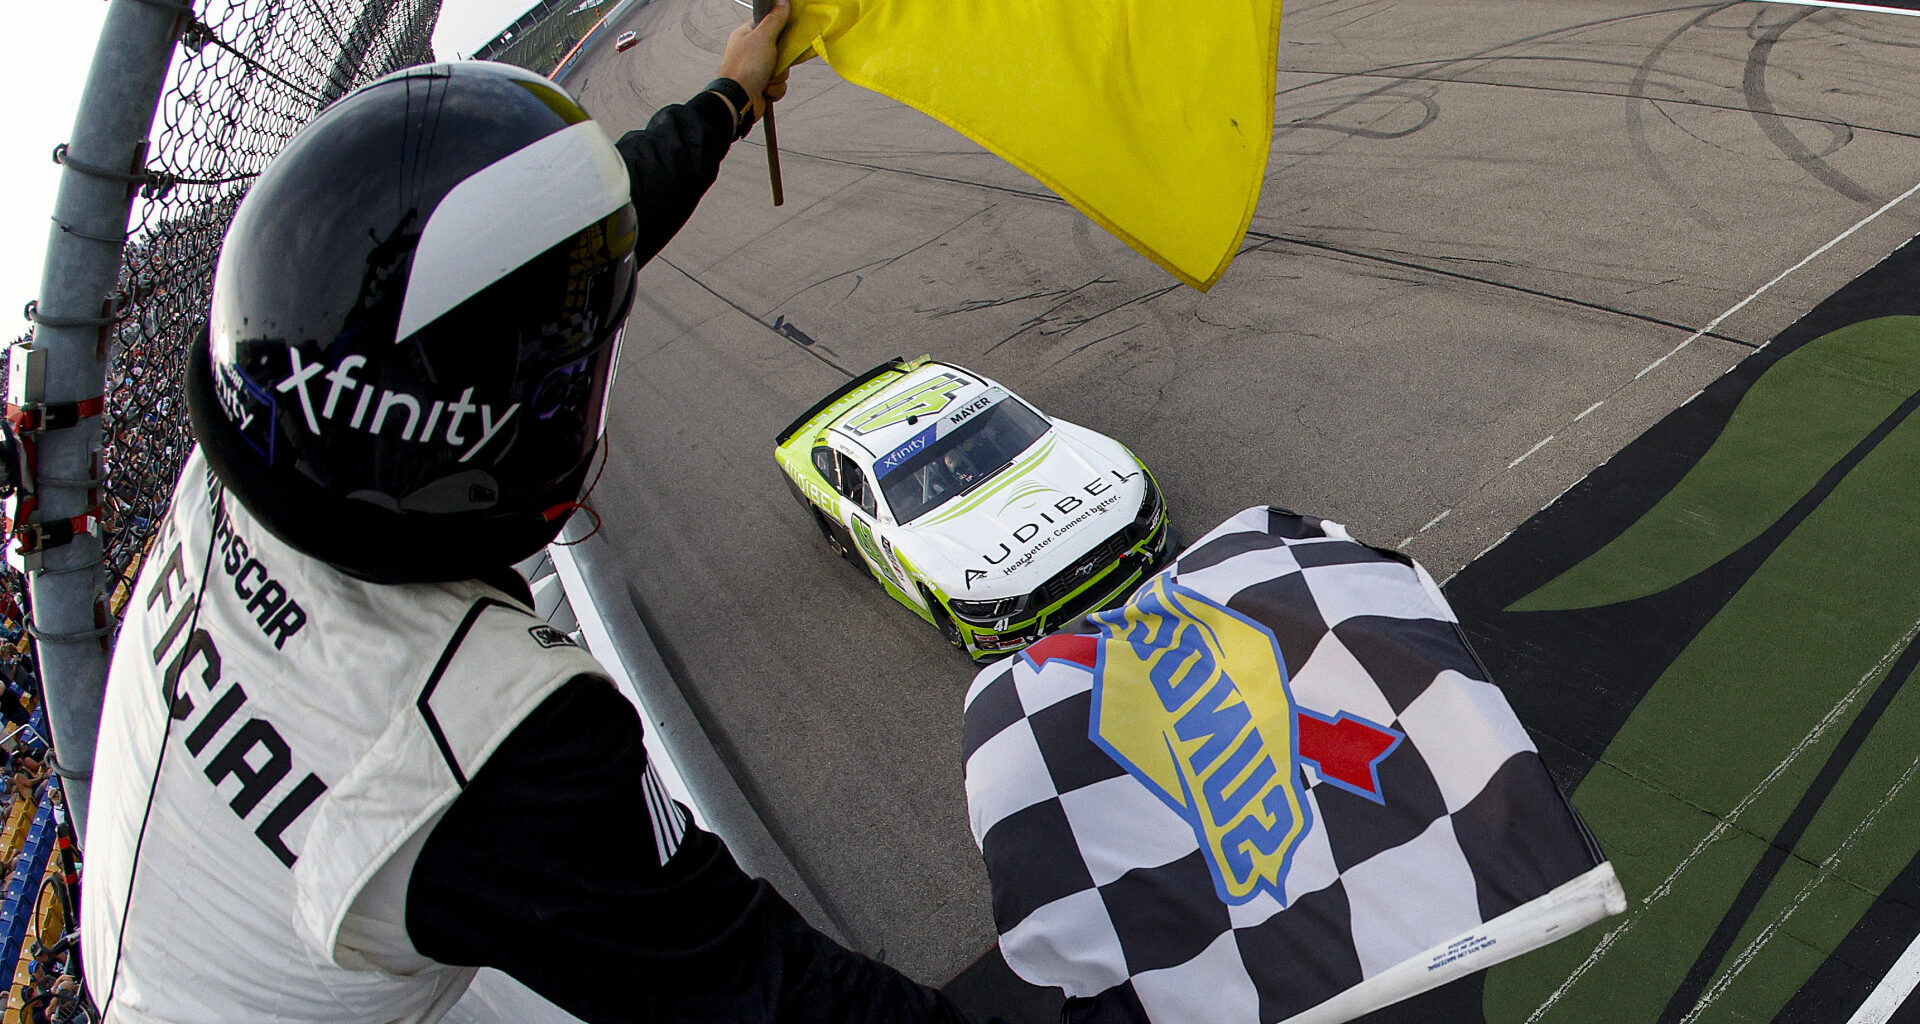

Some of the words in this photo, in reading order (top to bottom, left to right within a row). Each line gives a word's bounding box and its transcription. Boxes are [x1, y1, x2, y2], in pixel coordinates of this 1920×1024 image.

[276, 346, 521, 462] xfinity
[950, 397, 991, 424] MAYER
[884, 436, 926, 468] xfinity
[965, 470, 1139, 590] AUDIBEL
[1003, 556, 1027, 576] Hear
[1054, 511, 1091, 537] Connect
[993, 617, 1009, 632] 41
[147, 493, 328, 869] FFICIAL
[1428, 956, 1457, 971] MATERIAL
[1457, 946, 1480, 959] NYLON
